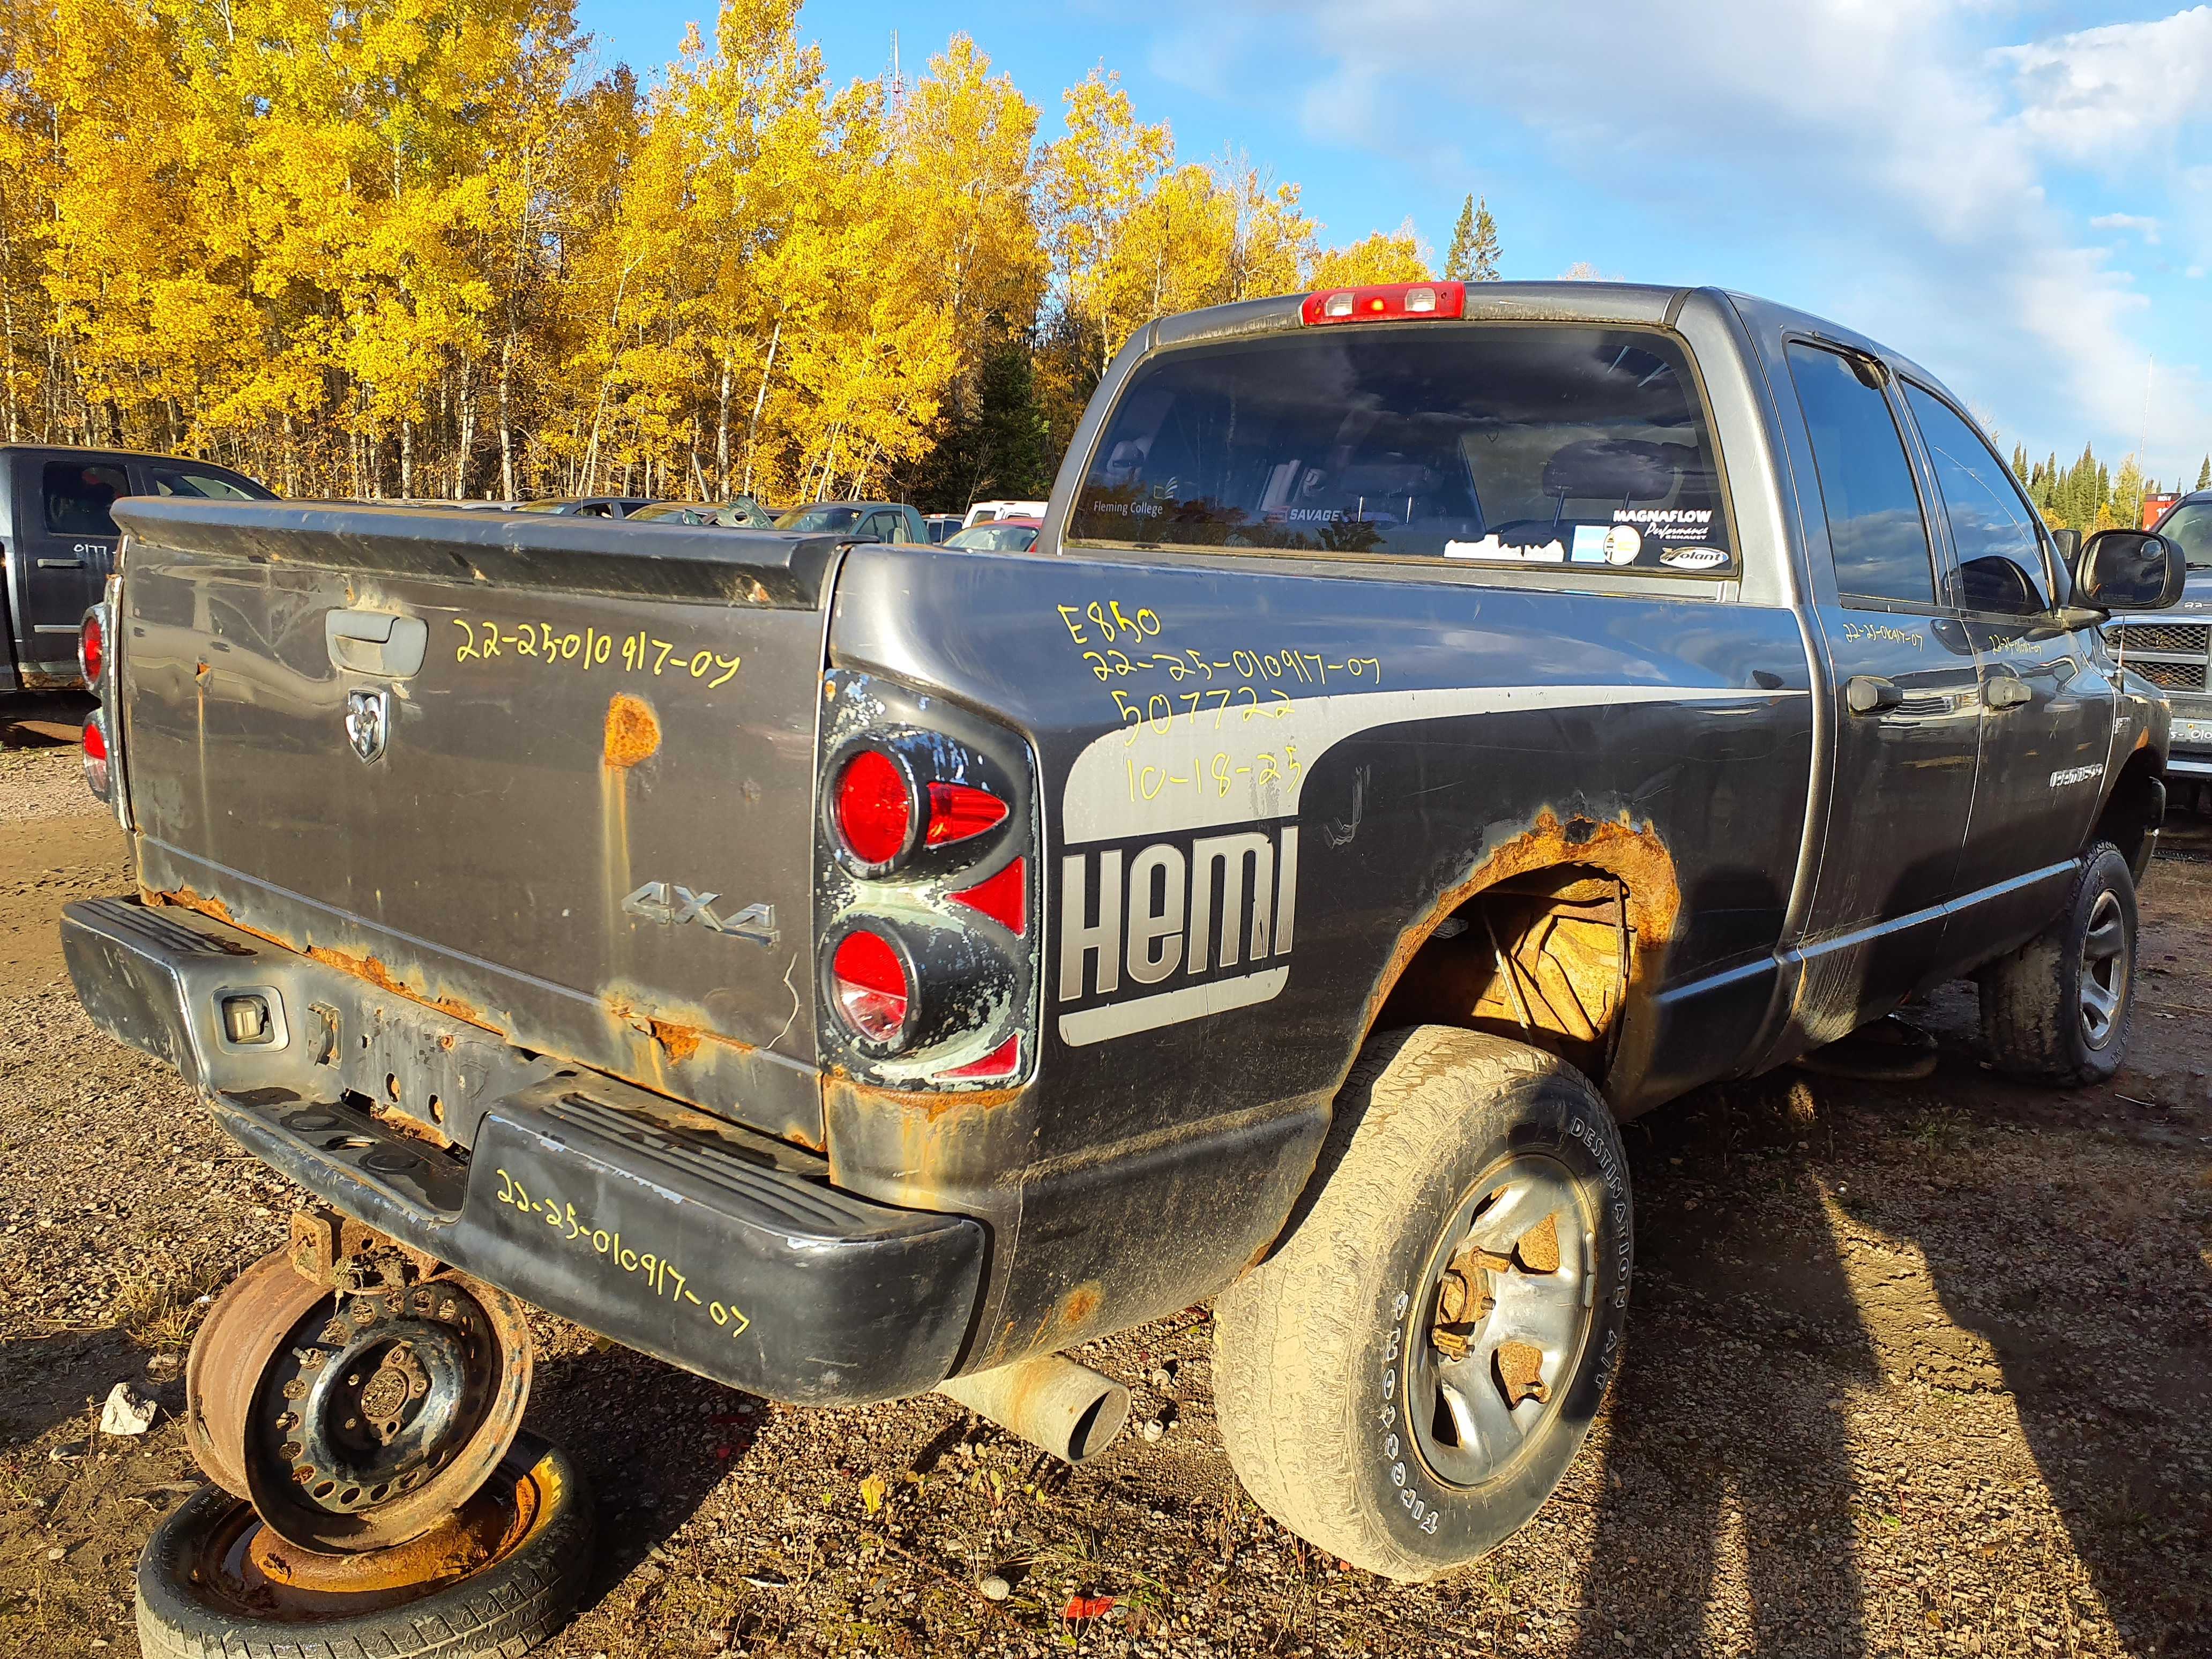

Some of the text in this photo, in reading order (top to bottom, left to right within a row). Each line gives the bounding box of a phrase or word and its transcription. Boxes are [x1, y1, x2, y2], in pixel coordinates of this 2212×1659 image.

[1094, 500, 1163, 517] Fleming College
[1290, 509, 1340, 521] SAVAGE
[1613, 510, 1712, 523] MAGNAFLOW
[1057, 600, 1161, 644] E850
[1083, 649, 1380, 685] 22-25-010917-07
[1111, 686, 1295, 746] 507722
[1127, 745, 1302, 803] 10-18-25
[1570, 1117, 1630, 1309] DESTINATION
